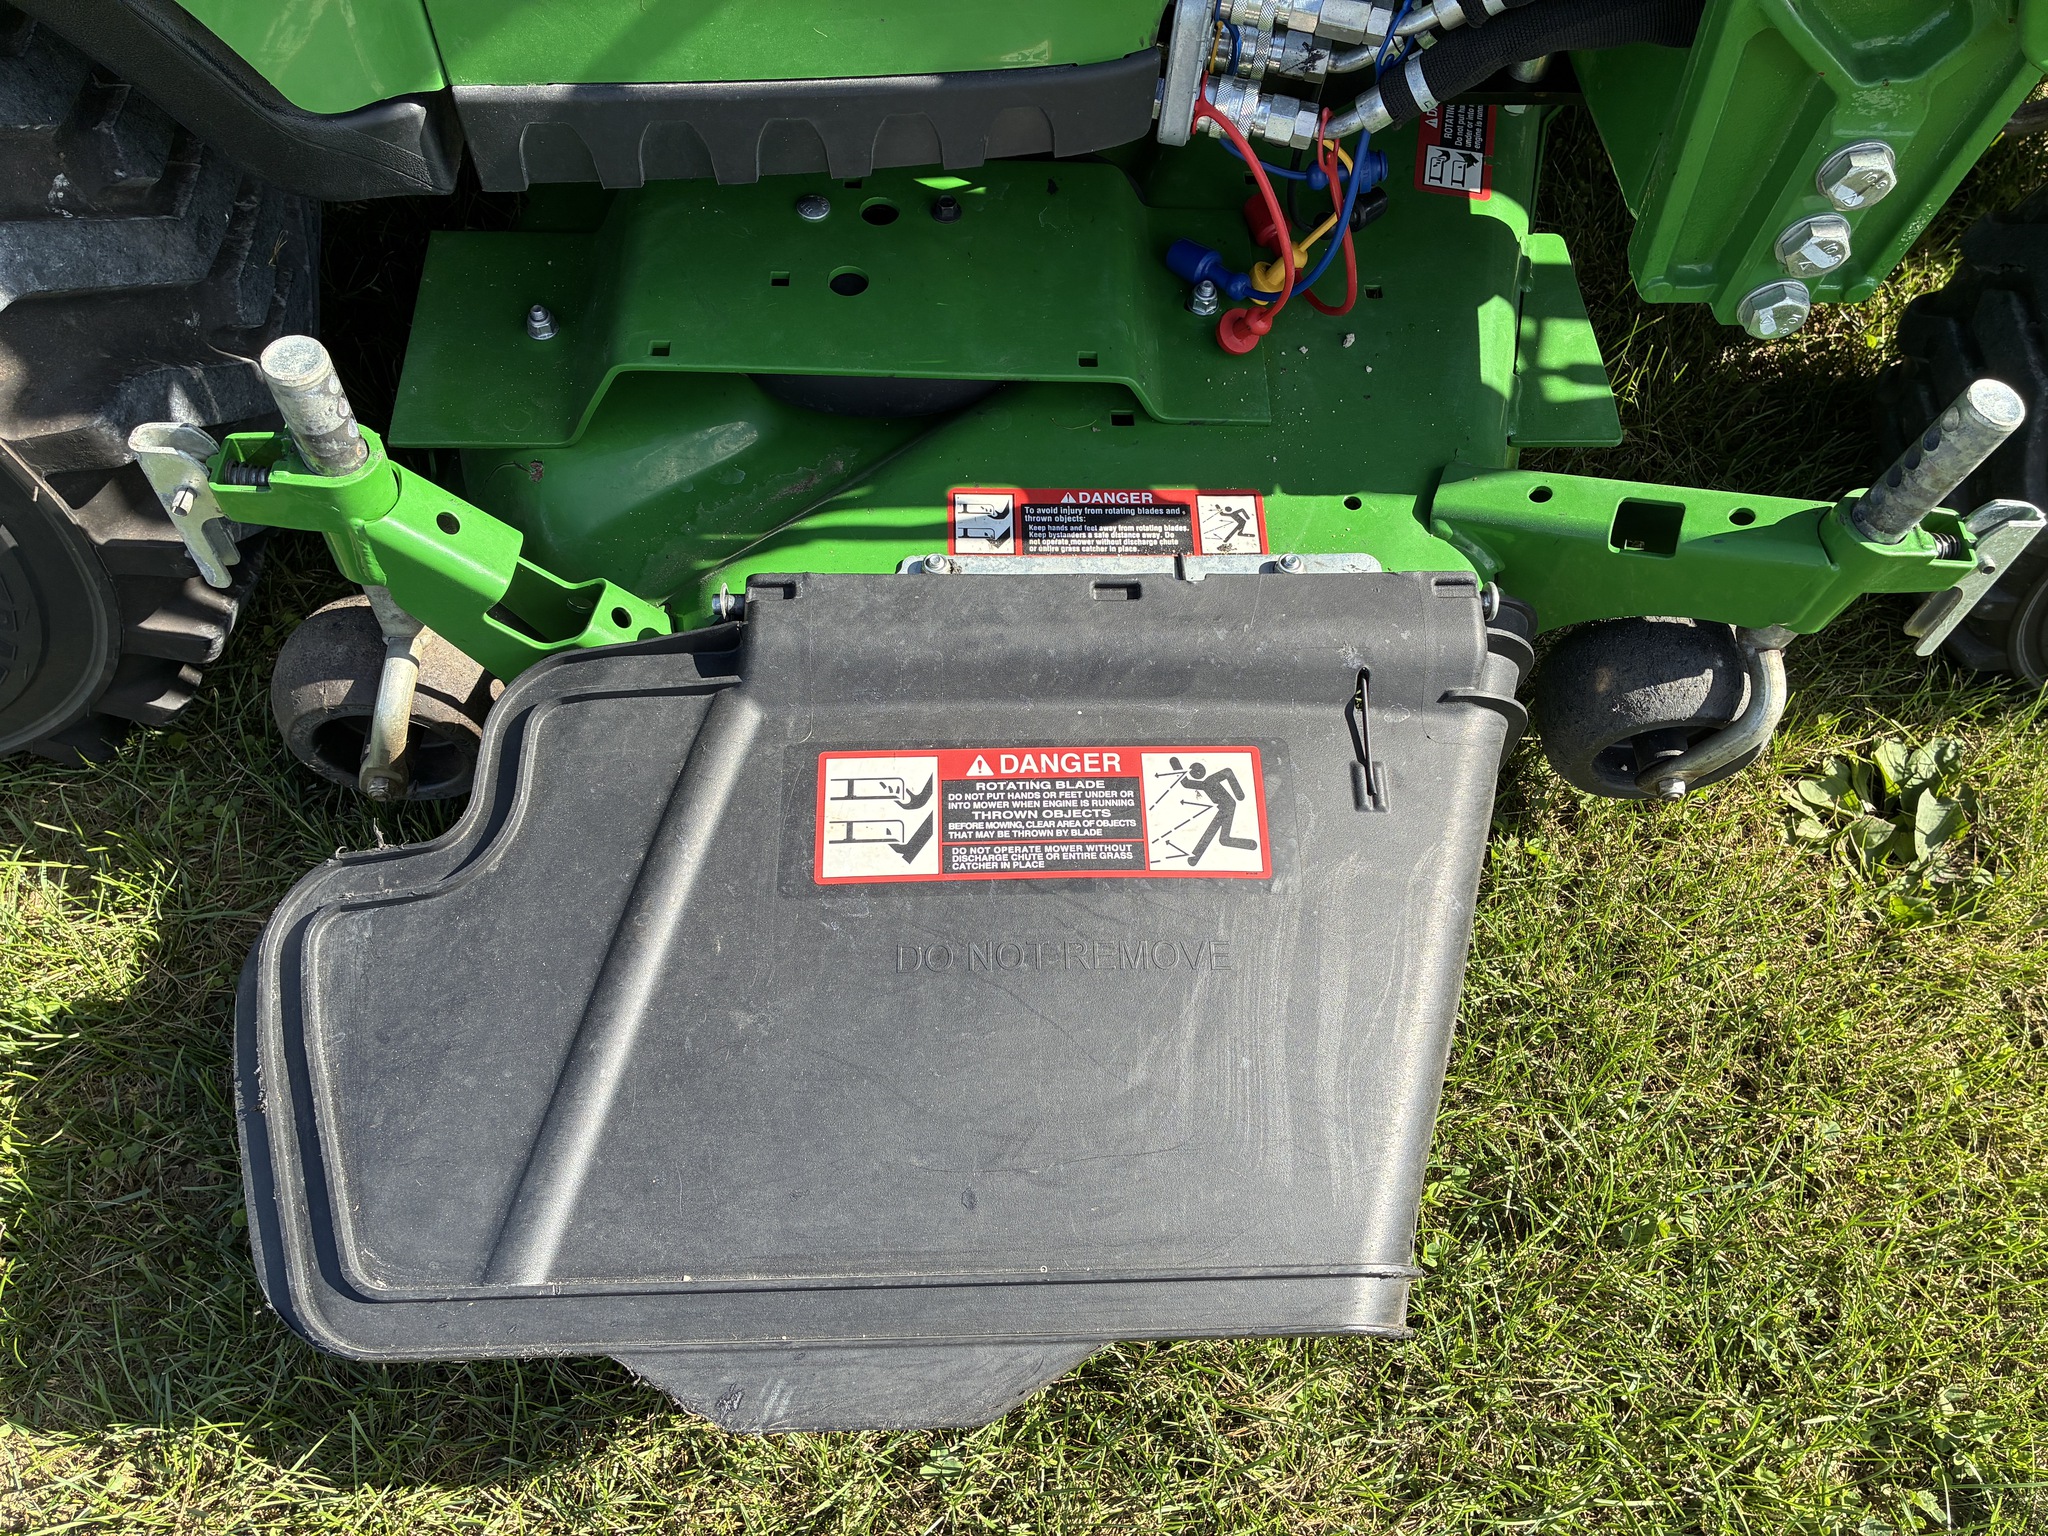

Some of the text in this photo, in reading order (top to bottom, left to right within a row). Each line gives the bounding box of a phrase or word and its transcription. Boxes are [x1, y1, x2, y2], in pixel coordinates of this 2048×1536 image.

[1458, 113, 1466, 125] put
[1466, 108, 1475, 121] into
[1467, 120, 1474, 129] or
[1454, 136, 1463, 146] Do
[1465, 129, 1473, 148] under
[1474, 128, 1483, 149] engine
[1079, 492, 1153, 504] DANGER
[1024, 505, 1181, 516] To avoid injury from rotating blades and
[1024, 514, 1086, 523] thrown objects:
[1028, 524, 1046, 532] Keep
[1098, 525, 1117, 533] away
[1164, 524, 1190, 532] blades.
[1028, 531, 1047, 539] Keep
[1141, 532, 1163, 540] away.
[1123, 538, 1158, 547] discharge
[1159, 538, 1179, 547] chute
[1117, 545, 1140, 553] place.
[1000, 753, 1121, 774] DANGER
[976, 780, 1105, 791] ROTATING BLADE
[948, 790, 1134, 801] DO NOT PUT HANDS OR FEET UNDER OR
[948, 799, 1135, 810] INTO MOWER WHEN ENGINE IS RUNNING
[972, 809, 1112, 820] THROWN OBJECTS
[948, 819, 1137, 830] BEFORE MOWING, CLEAR AREA OF OBJECTS
[948, 828, 1103, 839] THAT MAY BE THROWN BY BLADE
[952, 844, 1133, 855] DO NOT OPERATE MOWER WITHOUT
[952, 851, 1133, 863] DISCHARGE CHUTE OR ENTIRE GRASS
[952, 860, 1045, 870] CATCHER IN PLACE
[896, 939, 1233, 973] DO NOT REMOVE
